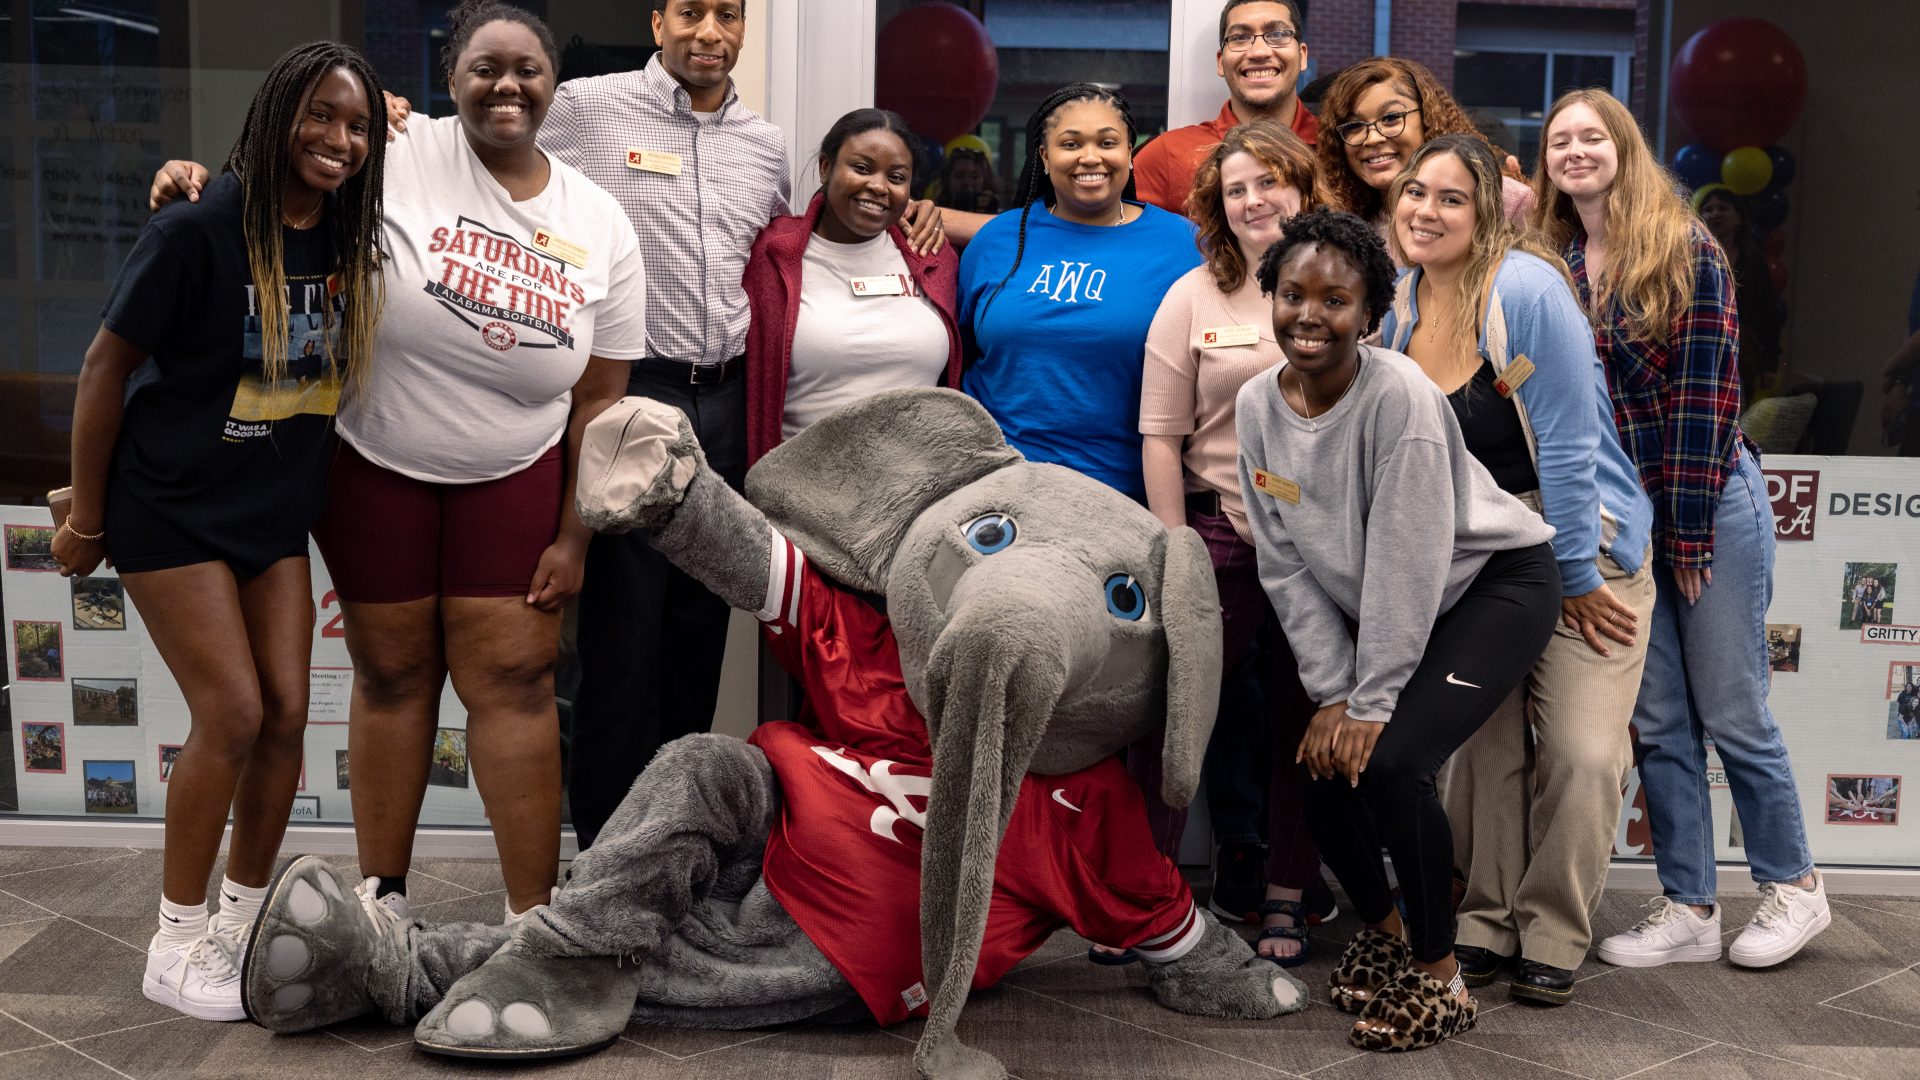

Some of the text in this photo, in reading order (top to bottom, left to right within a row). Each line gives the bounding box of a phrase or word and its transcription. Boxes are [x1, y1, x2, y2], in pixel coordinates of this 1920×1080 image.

[427, 226, 587, 306] SATURDAYS
[475, 261, 543, 292] ARE FOR
[441, 255, 572, 336] THE TIDE
[1026, 261, 1107, 303] AWQ
[441, 288, 564, 339] ALABAMA SOFTBALL
[224, 428, 272, 438] GOOD DAY
[225, 420, 237, 429] IT
[238, 424, 260, 432] WAS
[1828, 492, 1920, 518] DESIG
[1867, 627, 1919, 641] GRITTY
